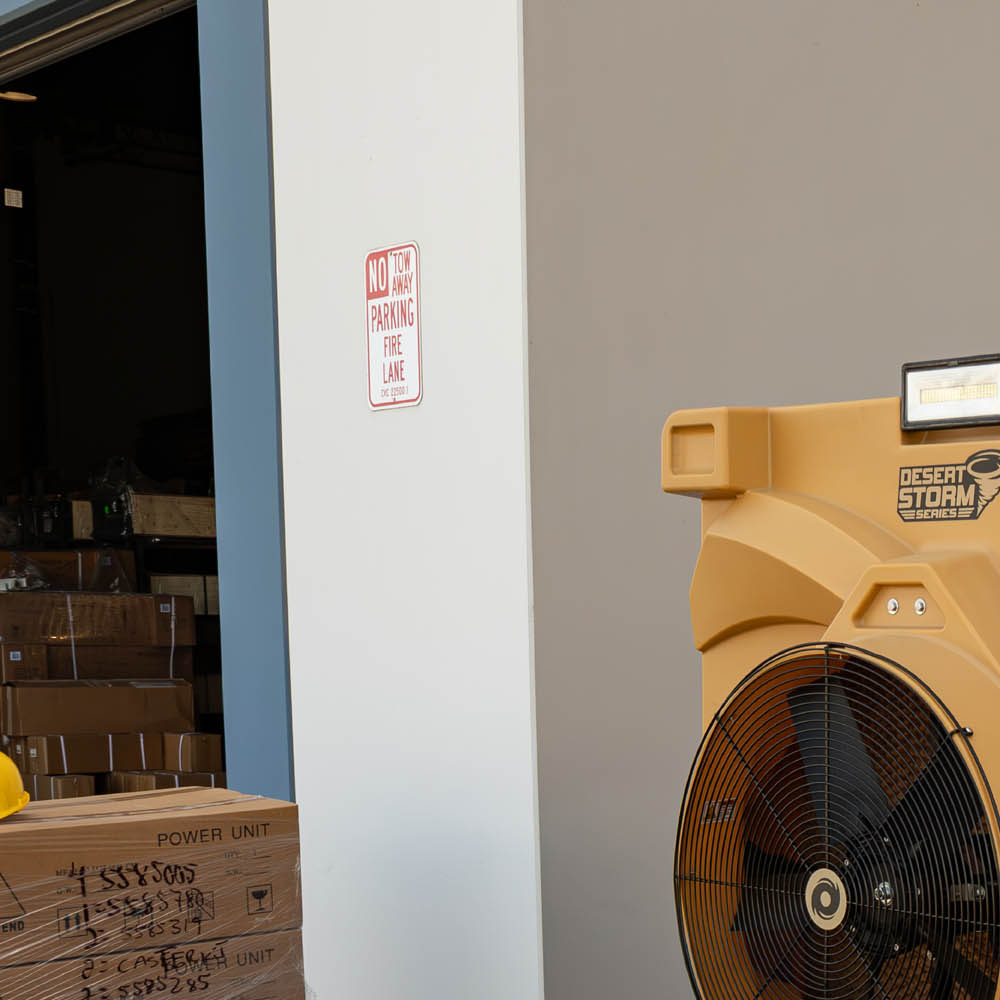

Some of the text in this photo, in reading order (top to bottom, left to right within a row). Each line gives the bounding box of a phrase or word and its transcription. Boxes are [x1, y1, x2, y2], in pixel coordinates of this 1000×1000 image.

[392, 251, 411, 274] TOW
[369, 256, 387, 294] NO
[392, 271, 413, 297] AWAY
[371, 297, 414, 333] PARKING
[384, 334, 403, 358] FIRE
[382, 360, 405, 384] LANE
[900, 465, 967, 486] DESERT
[898, 484, 976, 508] STORM
[915, 508, 957, 519] SERIES
[157, 823, 270, 847] POWER UNIT
[2, 921, 25, 933] END
[236, 948, 274, 967] UNIT
